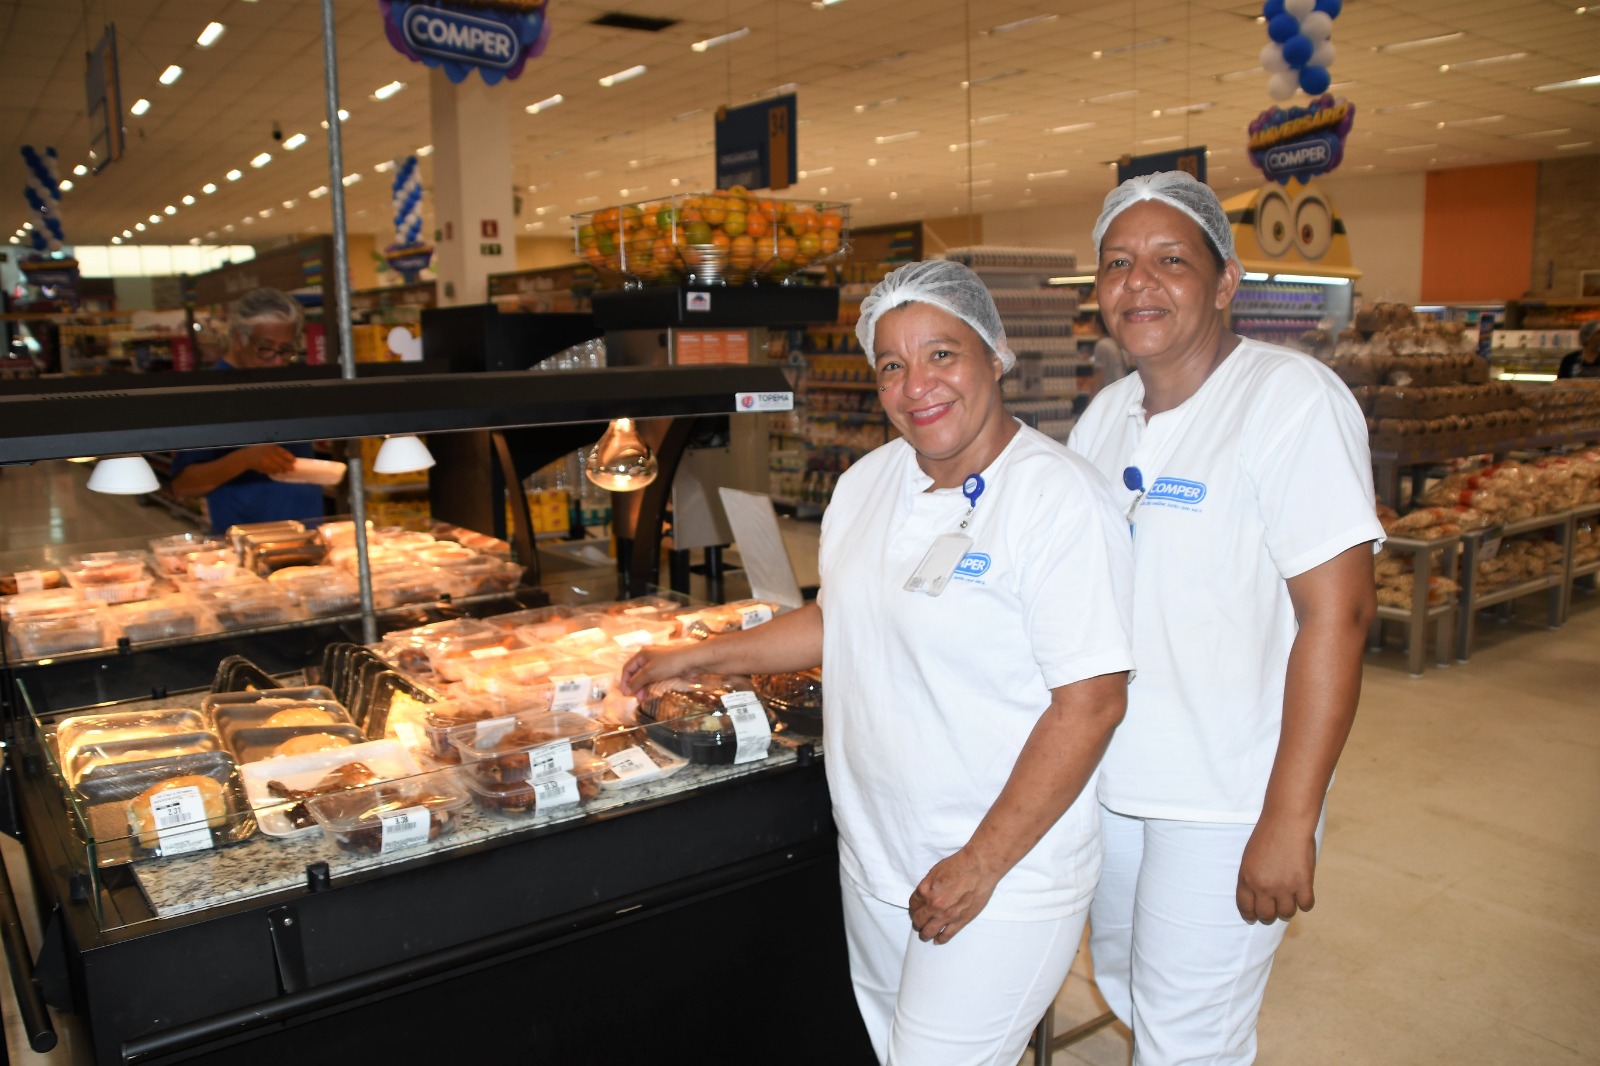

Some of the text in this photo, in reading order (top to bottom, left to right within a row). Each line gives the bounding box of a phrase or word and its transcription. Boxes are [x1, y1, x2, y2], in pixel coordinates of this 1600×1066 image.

[411, 14, 510, 57] COMPER
[1269, 145, 1326, 168] COMPER
[758, 394, 790, 402] TOPEMA
[1150, 482, 1201, 499] COMPER
